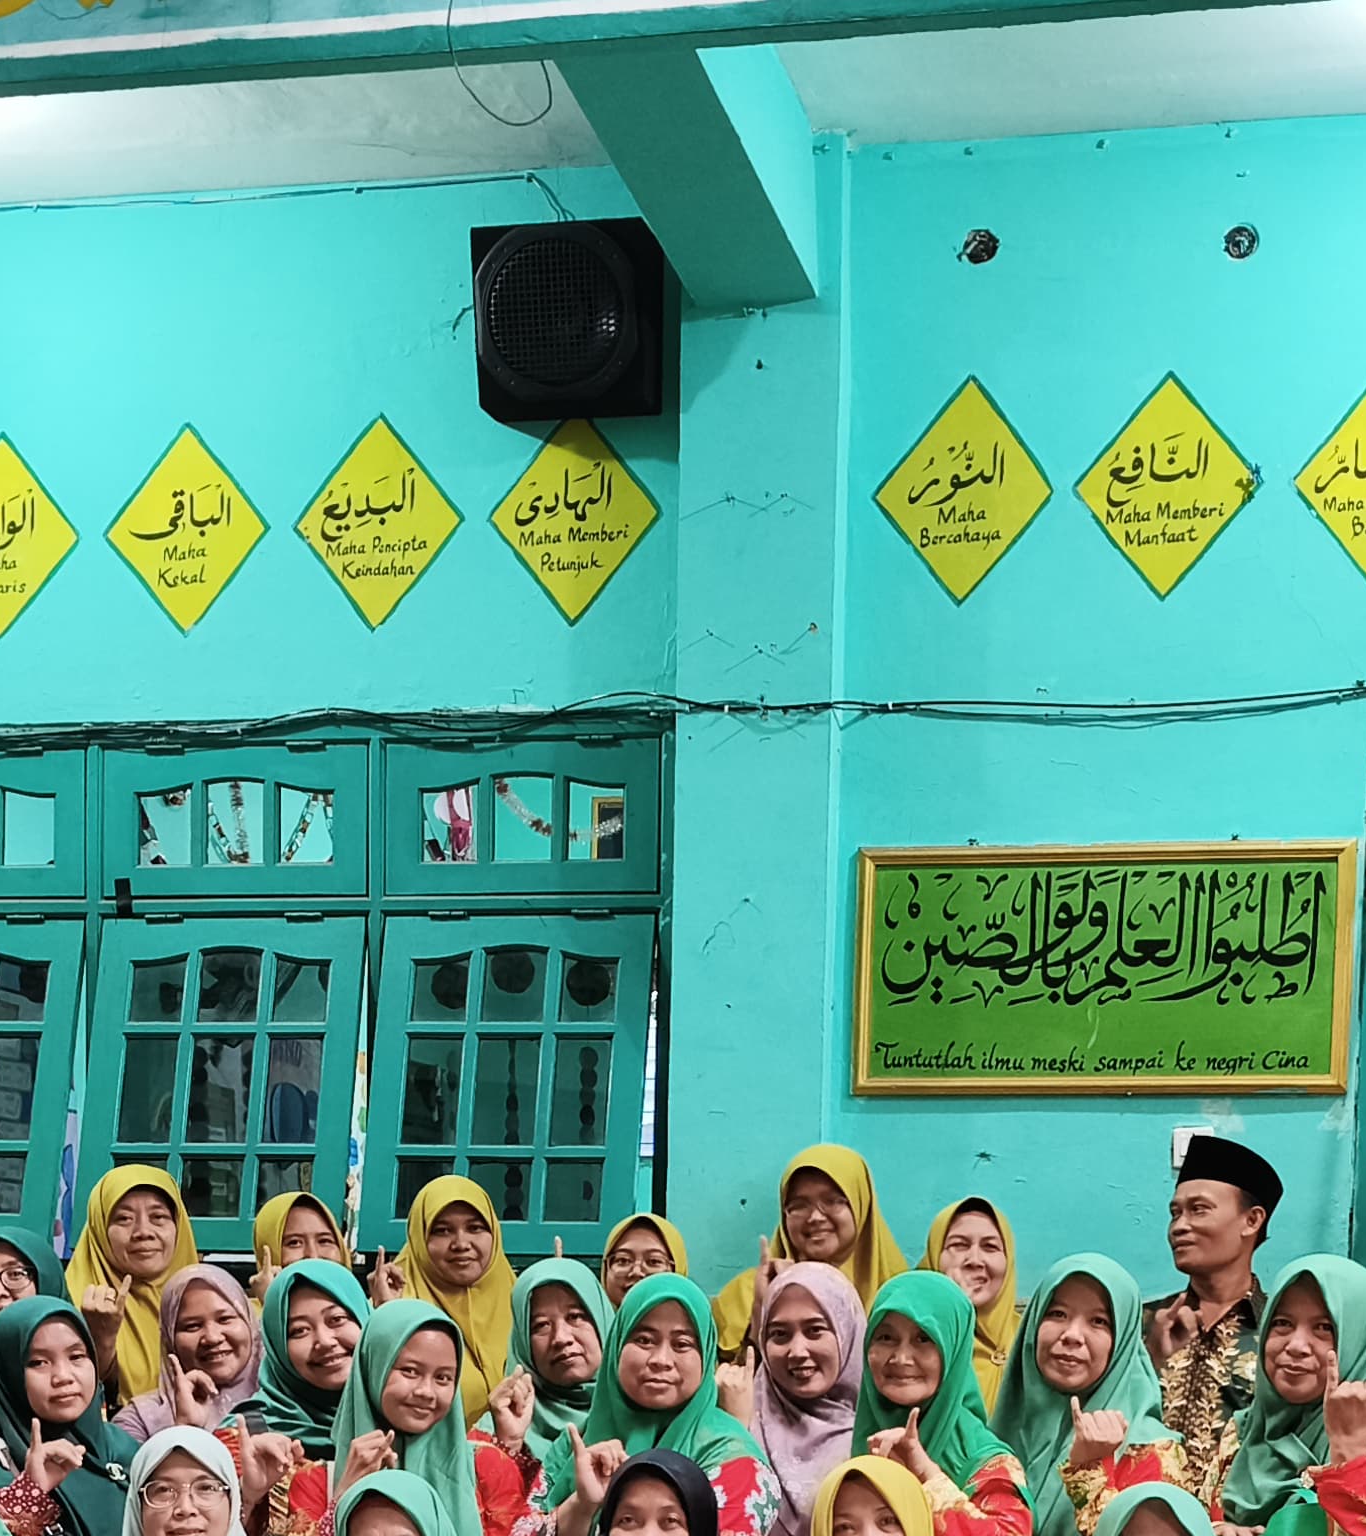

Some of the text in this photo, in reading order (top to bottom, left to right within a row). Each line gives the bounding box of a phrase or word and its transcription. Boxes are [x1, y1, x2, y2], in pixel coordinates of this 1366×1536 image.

[937, 502, 987, 525] Maha
[1106, 500, 1225, 525] Maha Memberi
[1323, 496, 1364, 513] Maha
[519, 522, 630, 548] Maha Memberi
[919, 525, 1002, 551] Bercahaya
[1124, 525, 1199, 548] Manfaat
[163, 543, 207, 563] Maha
[325, 536, 428, 559] Maha Pencipta
[341, 559, 416, 580] Keindahan
[540, 551, 604, 578] Petunjuk
[158, 566, 206, 588] Kekal
[874, 1040, 1309, 1076] Tuntutlah ilmu meski sampai ke negri Cina
